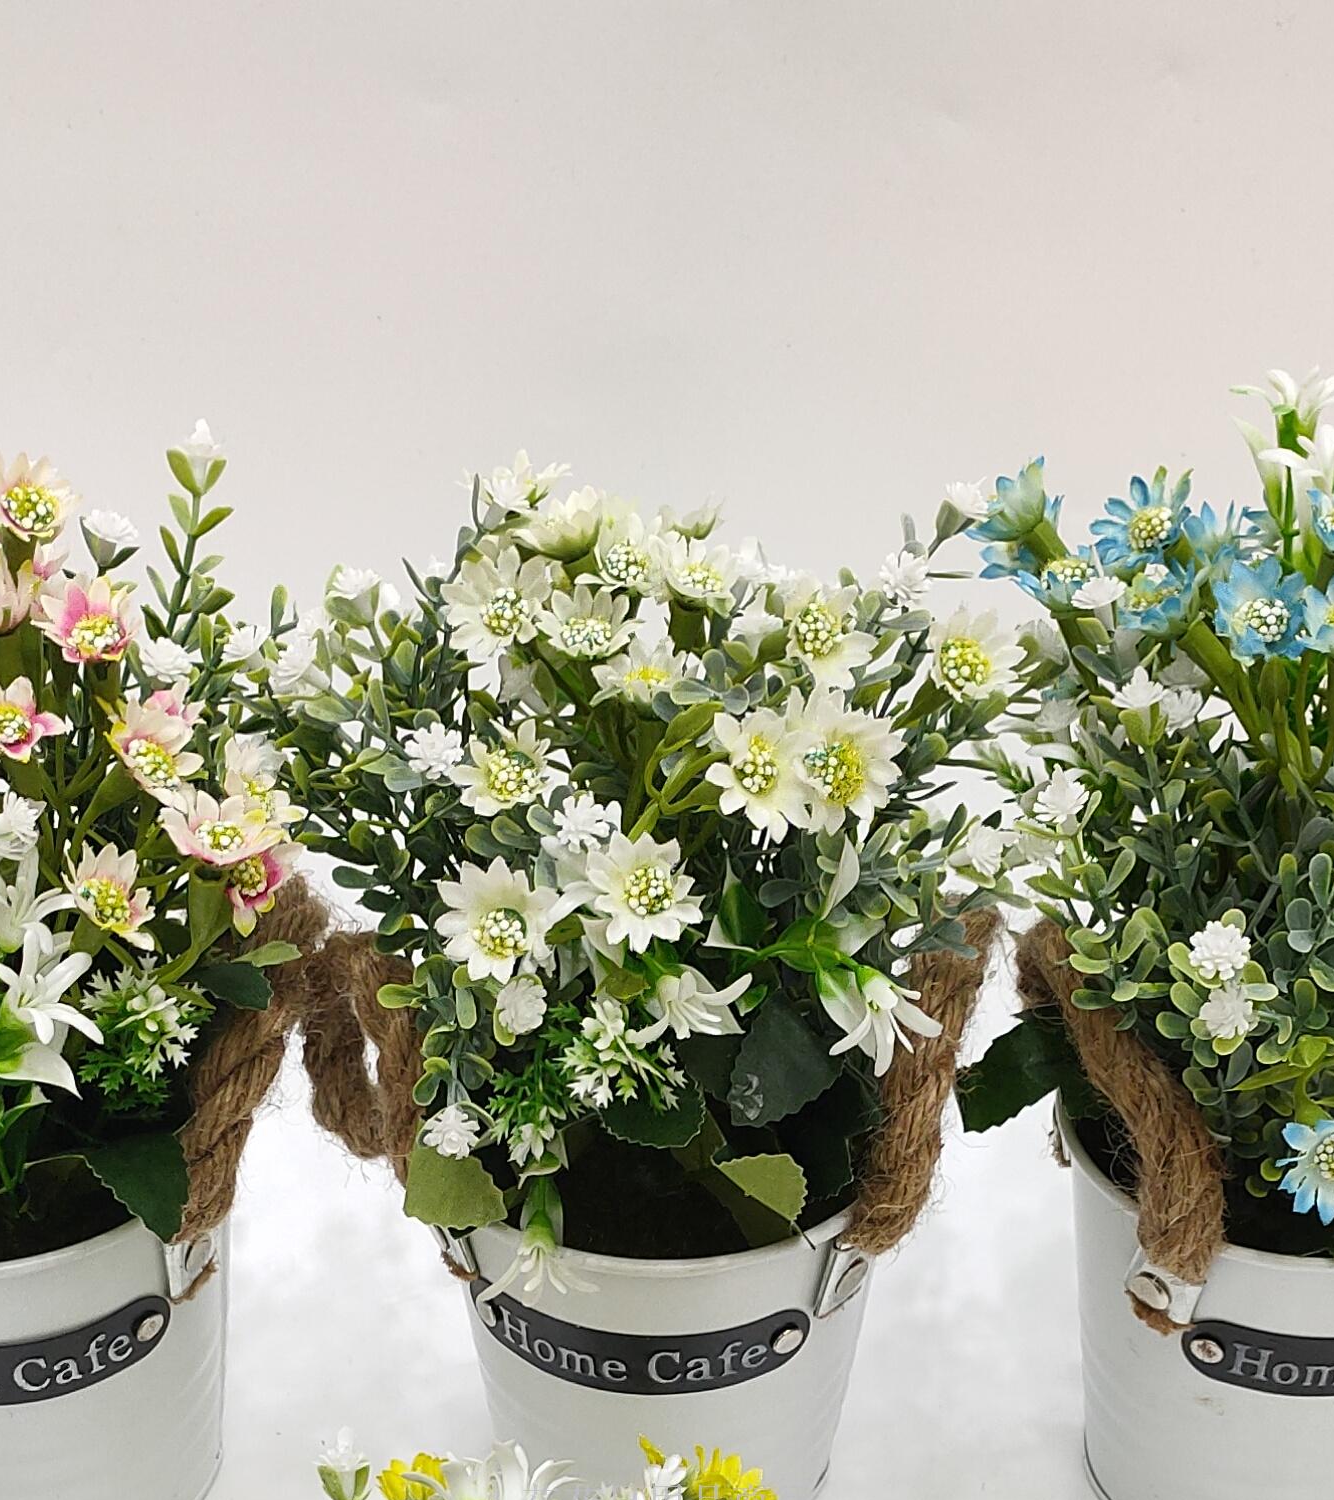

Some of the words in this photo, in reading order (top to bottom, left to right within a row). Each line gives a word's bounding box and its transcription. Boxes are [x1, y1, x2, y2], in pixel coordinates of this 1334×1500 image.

[12, 1333, 134, 1393] Cafe
[499, 1305, 628, 1382] Home
[647, 1341, 768, 1384] Cafe
